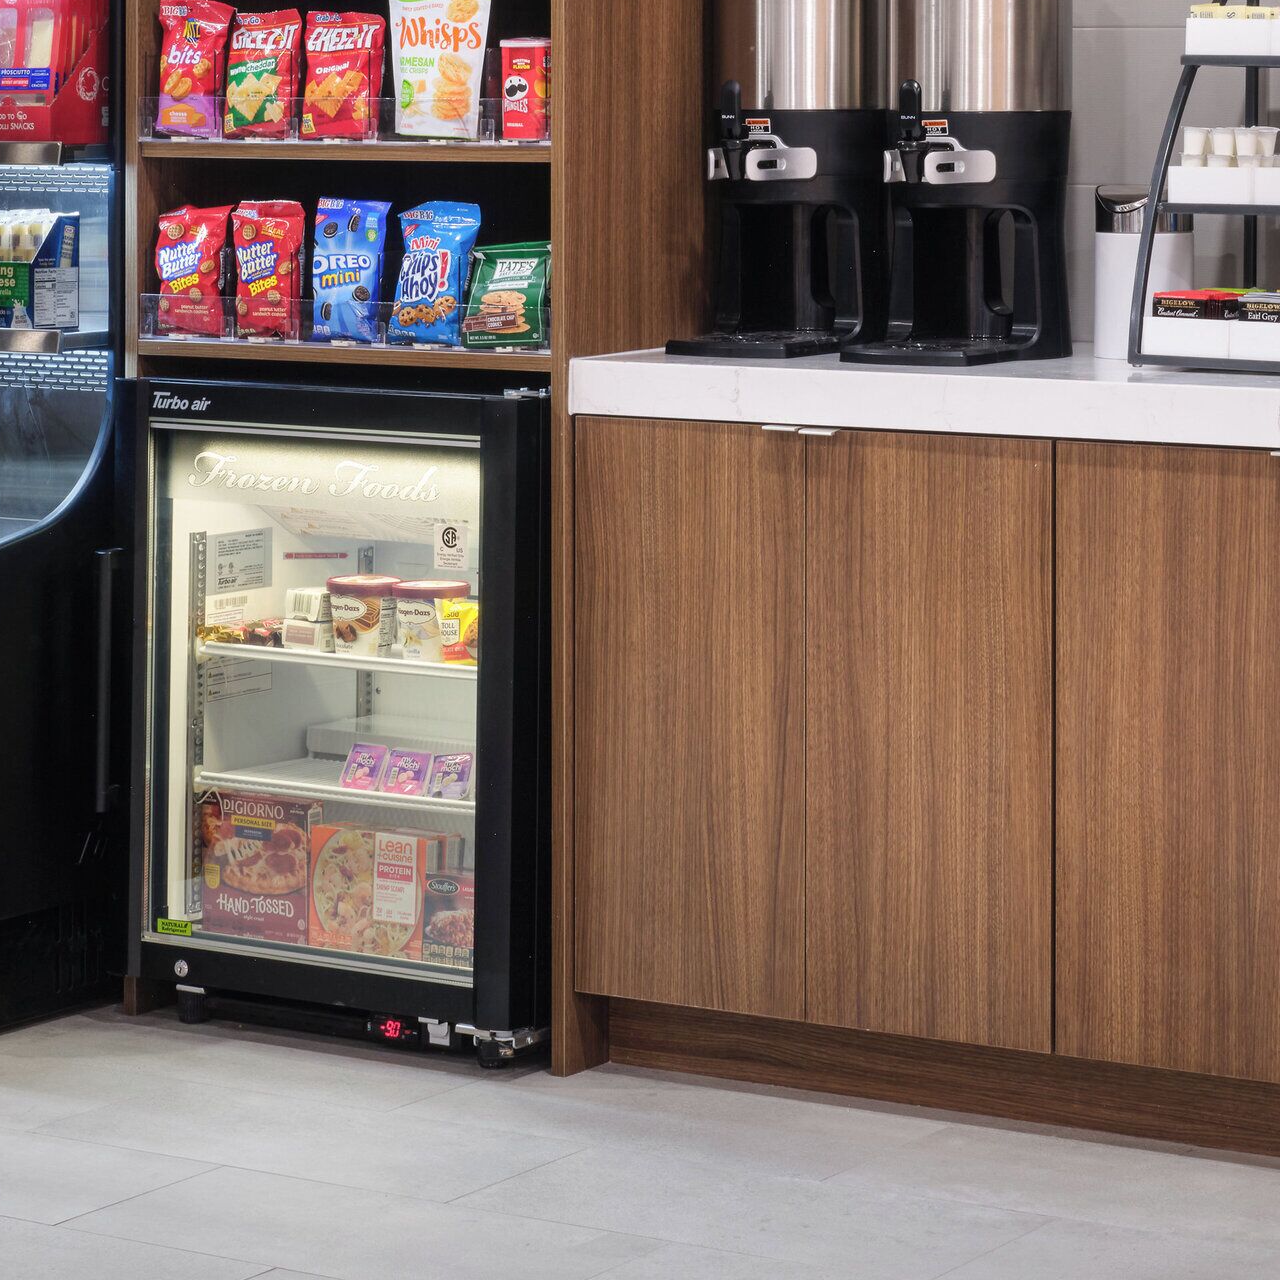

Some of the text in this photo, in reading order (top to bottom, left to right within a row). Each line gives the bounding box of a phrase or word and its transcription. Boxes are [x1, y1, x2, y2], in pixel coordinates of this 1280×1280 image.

[395, 16, 482, 52] Whisps
[168, 45, 201, 64] bits
[504, 99, 528, 113] PRINGLES
[160, 241, 197, 263] Nutter
[238, 241, 273, 261] Nutter
[411, 237, 440, 250] Mini
[162, 251, 201, 277] Butter
[241, 252, 277, 278] Butter
[313, 255, 370, 274] OREO
[402, 252, 439, 280] Chips
[499, 261, 536, 271] TATE'S
[169, 273, 199, 293] Bites
[249, 276, 278, 296] Bites
[321, 269, 360, 288] mini
[1247, 312, 1278, 322] Earl Grey
[153, 391, 211, 411] Turbo air
[188, 451, 440, 502] Frozen Foods
[379, 839, 412, 854] Lean
[379, 865, 411, 876] PROTEIN
[216, 894, 294, 917] HAND-TOSSED
